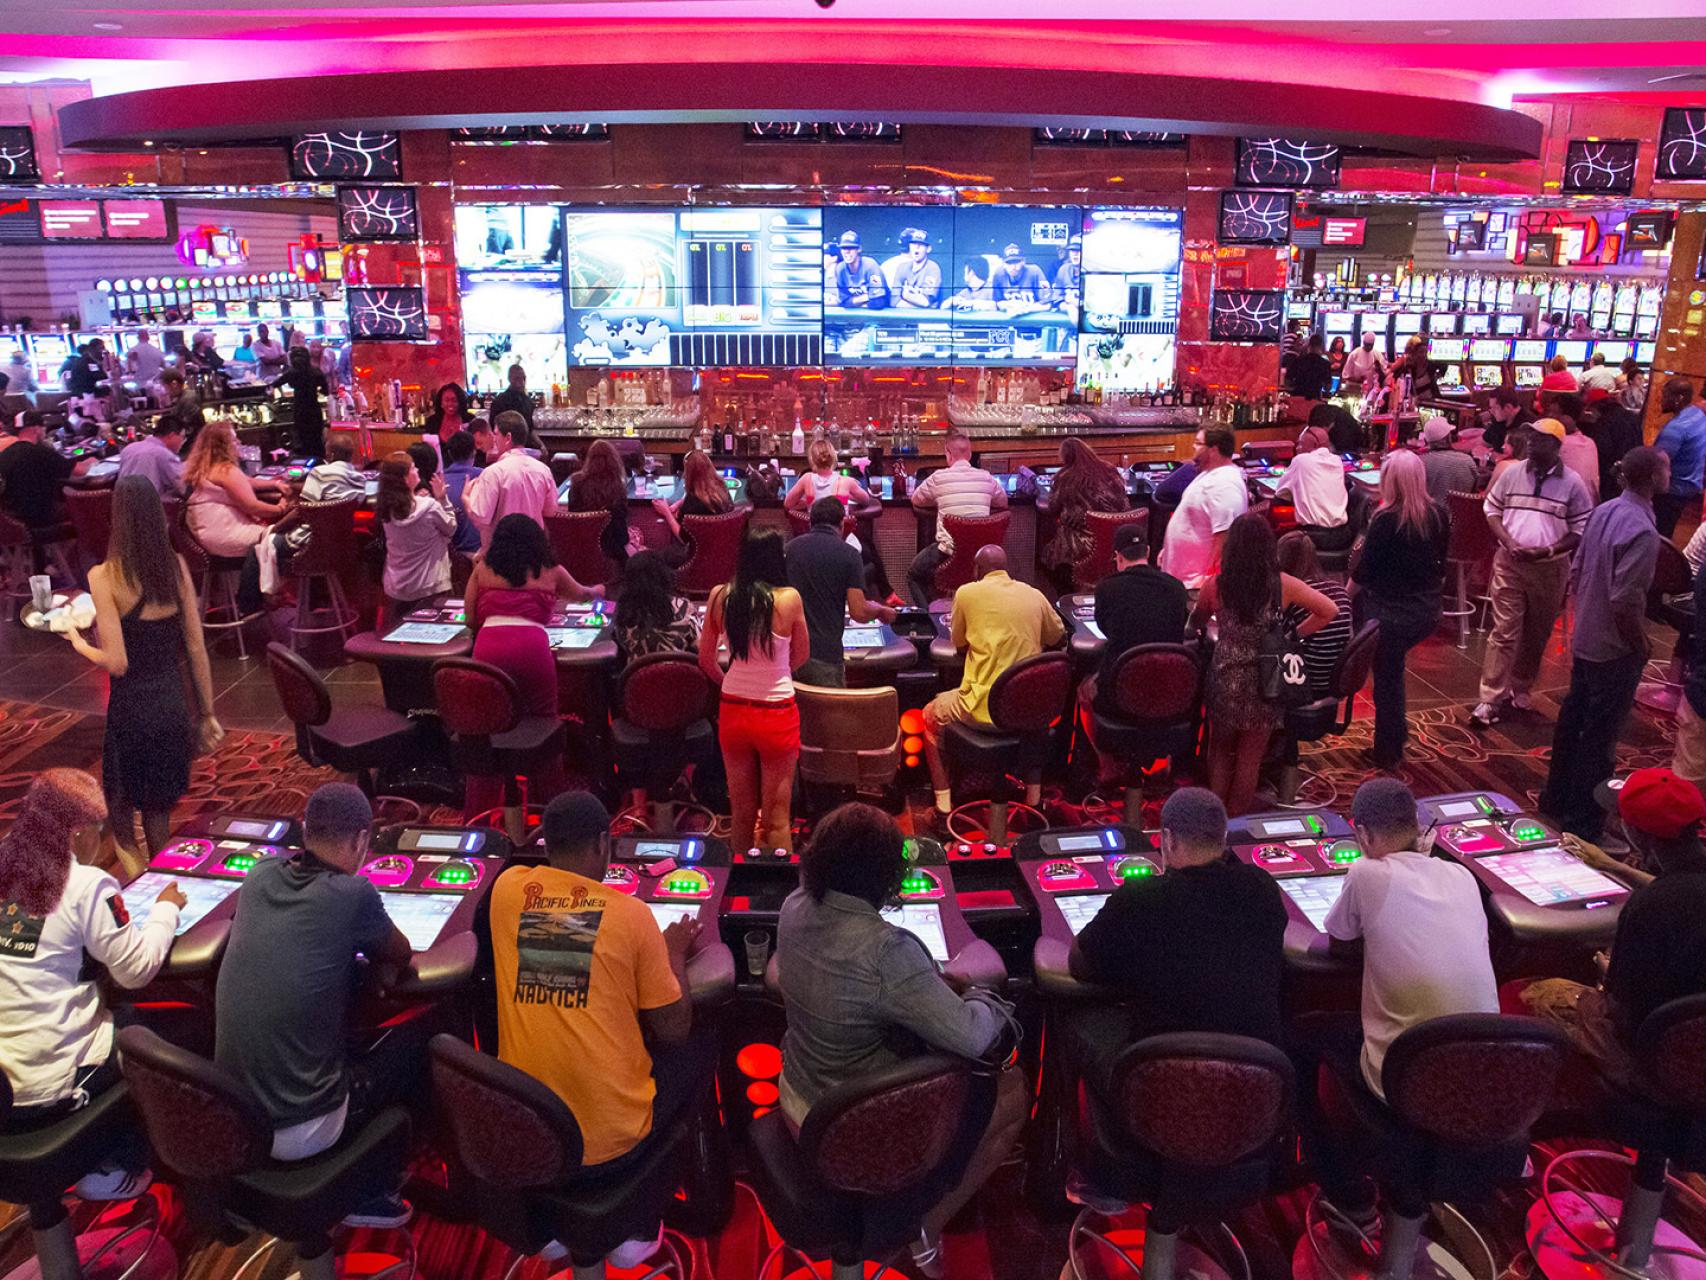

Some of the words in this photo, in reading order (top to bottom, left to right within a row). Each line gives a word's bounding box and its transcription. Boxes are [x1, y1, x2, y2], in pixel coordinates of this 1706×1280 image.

[523, 881, 570, 911] PACIFIC
[570, 885, 607, 910] PINES
[513, 983, 589, 1009] NAUTICA
